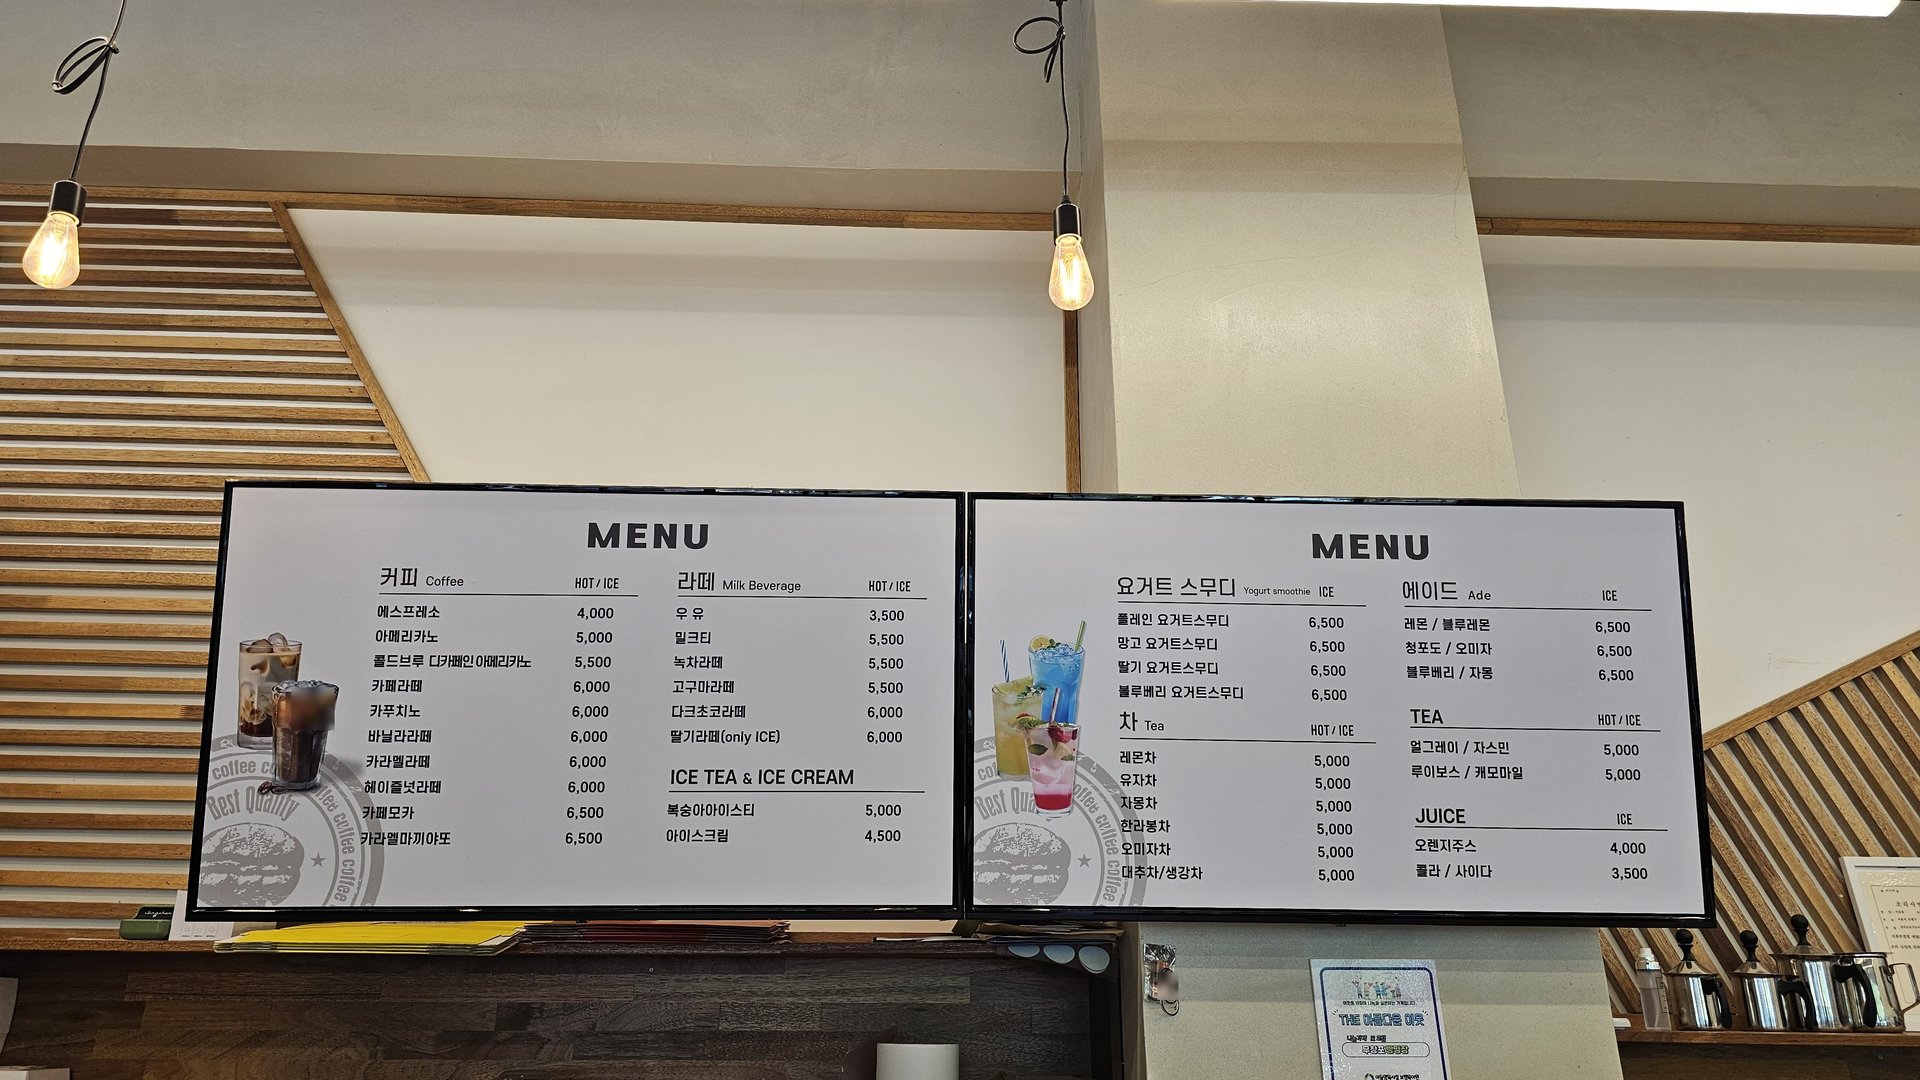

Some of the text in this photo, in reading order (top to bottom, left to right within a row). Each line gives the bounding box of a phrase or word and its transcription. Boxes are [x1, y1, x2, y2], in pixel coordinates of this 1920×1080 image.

[588, 523, 708, 549] MENU
[1312, 534, 1428, 560] MENU
[381, 568, 463, 587] 커피 Coffee
[575, 578, 619, 588] HOT / ICE
[679, 572, 800, 593] 라떼 Milk Beverage
[869, 581, 910, 591] HOT / ICE
[1118, 577, 1172, 595] 요거트
[1181, 578, 1235, 597] 스무디
[1244, 587, 1270, 596] Yogurt
[1320, 587, 1334, 597] ICE
[1403, 582, 1491, 600] 에이드 Ade
[1603, 590, 1617, 601] ICE
[378, 606, 439, 618] 에스프레소
[578, 608, 613, 620] 4,000
[870, 610, 904, 622] 3,500
[1118, 613, 1228, 627] 플레인 요거트스무디
[1309, 617, 1343, 629] 6,500
[1405, 617, 1490, 631] 레몬 / 블루레몬
[1596, 622, 1630, 633] 6,500
[376, 630, 438, 643] 아메리카노
[577, 632, 612, 644] 5,000
[676, 632, 710, 644] 밀크티
[870, 634, 903, 646] 5,500
[1118, 637, 1217, 650] 망고 요거트스무디
[1310, 641, 1344, 653] 6,500
[1406, 641, 1492, 656] 청포도 / 오미자
[1597, 646, 1631, 657] 6,500
[374, 655, 531, 667] 콜드브루 디카페인 아메리카노
[575, 657, 611, 669] 5,500
[674, 656, 722, 668] 녹차라떼
[869, 658, 903, 670] 5,500
[1119, 661, 1218, 674] 딸기 요거트스무디
[1311, 665, 1345, 677] 6,500
[1407, 665, 1492, 680] 블루베리 / 자몽
[1599, 670, 1633, 681] 6,500
[372, 680, 422, 692] 카페라떼
[574, 681, 610, 694] 6,000
[673, 681, 734, 693] 고구마라떼
[869, 682, 903, 694] 5,500
[1119, 685, 1243, 699] 블루베리 요거트스무디
[1312, 689, 1346, 701] 6,500
[370, 705, 420, 717] 카푸치노
[573, 706, 608, 718] 6,000
[672, 705, 745, 718] 다크초코라떼
[868, 707, 902, 719] 6,000
[1410, 709, 1443, 724] TEA
[1120, 712, 1164, 731] 차 Tea
[1598, 714, 1640, 725] HOT / ICE
[369, 730, 431, 742] 바닐라라떼
[756, 730, 779, 743] ICE)
[1311, 725, 1354, 736] HOT / ICE
[571, 731, 607, 743] 6,000
[867, 731, 902, 744] 6,000
[1411, 740, 1509, 755] 얼그레이 / 자스민
[1604, 744, 1639, 756] 5,000
[367, 755, 430, 768] 카라멜라떼
[570, 756, 606, 769] 6,000
[1120, 751, 1156, 764] 레몬차
[1315, 755, 1349, 768] 5,000
[671, 769, 853, 784] ICE TEA & ICE CREAM
[1412, 765, 1523, 780] 루이보스 / 캐모마일
[1606, 769, 1640, 781] 5,000
[1121, 774, 1157, 786] 유자차
[1316, 778, 1350, 790] 5,000
[365, 781, 441, 794] 헤이즐넛라떼
[568, 782, 605, 794] 6,000
[1121, 797, 1157, 809] 자몽차
[1317, 801, 1351, 813] 5,000
[363, 807, 414, 819] 카페모카
[567, 807, 603, 819] 6,500
[668, 804, 754, 817] 복숭아아이스티
[866, 805, 901, 817] 5,000
[1416, 809, 1465, 823] JUICE
[1617, 814, 1632, 824] ICE
[1121, 819, 1170, 832] 한라봉차
[1317, 824, 1352, 836] 5,000
[361, 832, 450, 845] 카라멜마끼야또
[566, 833, 602, 845] 6,500
[667, 830, 728, 842] 아이스크림
[865, 830, 900, 843] 4,500
[1122, 843, 1170, 855] 오미자차
[1416, 839, 1476, 852] 오렌지주스
[1611, 843, 1645, 855] 4,000
[1318, 847, 1353, 859] 5,000
[1122, 865, 1203, 879] 대추차/생강차
[1319, 870, 1354, 882] 5,000
[1416, 863, 1492, 878] 콜라 / 사이다
[1612, 868, 1647, 880] 3,500
